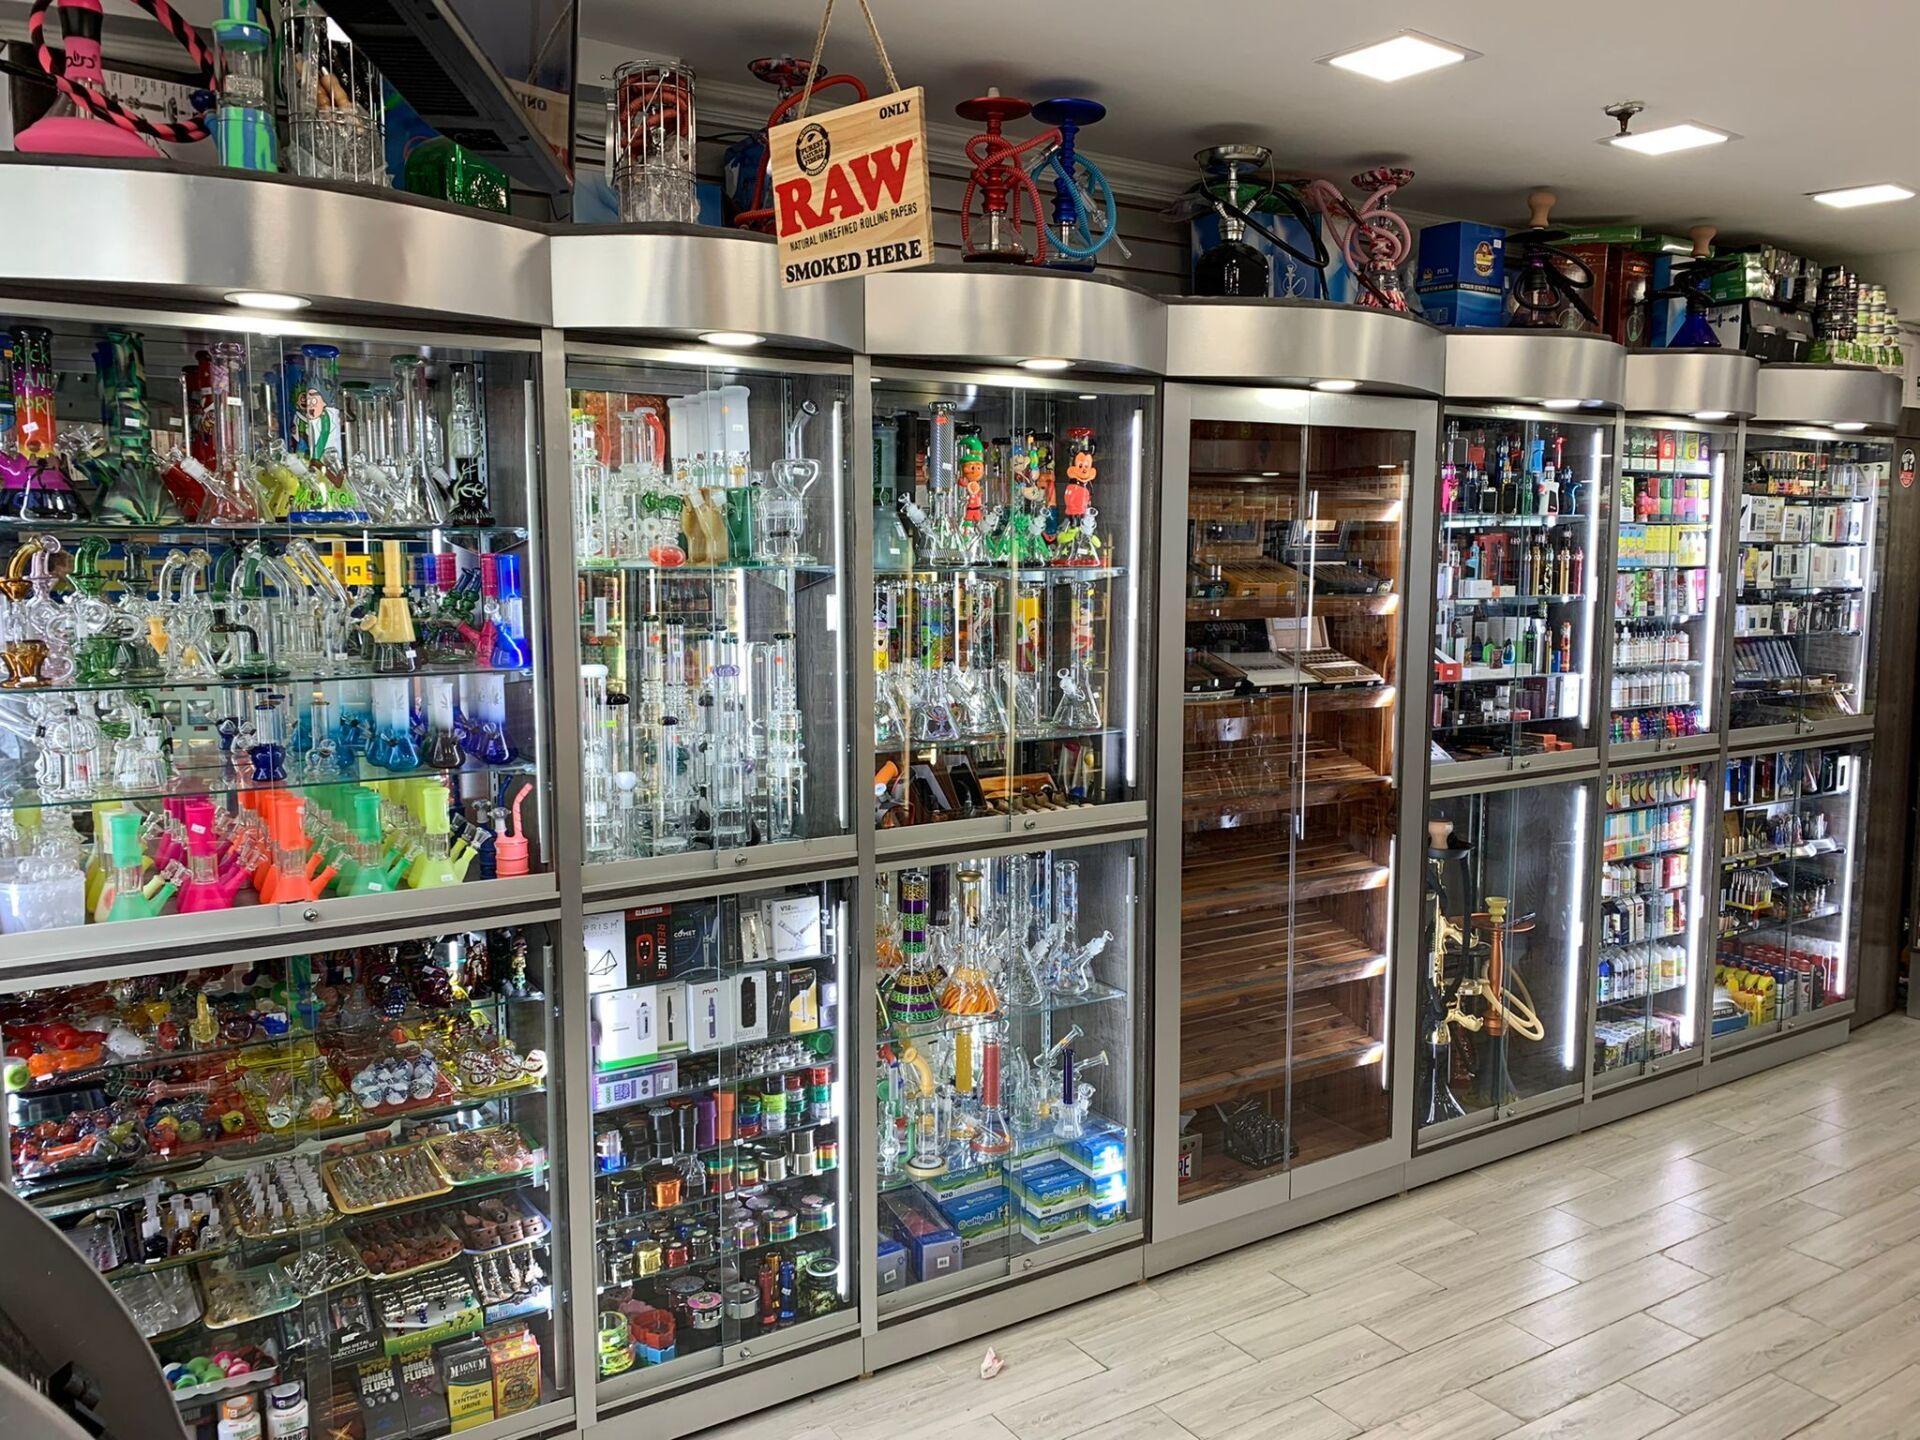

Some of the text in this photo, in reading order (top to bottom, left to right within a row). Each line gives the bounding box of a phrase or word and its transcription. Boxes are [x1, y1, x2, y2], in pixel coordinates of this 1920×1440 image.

[879, 100, 911, 119] ONLY
[801, 139, 824, 153] PUREST
[802, 148, 824, 160] NATURAL
[775, 138, 914, 238] RAW
[790, 202, 918, 251] NATURAL UNREFINED ROLLING PAPERS
[786, 239, 922, 283] SMOKED HERE
[13, 345, 49, 363] RICK
[583, 922, 617, 931] PRISM
[674, 928, 696, 938] COMET
[402, 1358, 433, 1374] DOUBLE
[403, 1366, 435, 1383] FLUSH
[450, 1358, 487, 1378] MAGNUM
[361, 1369, 393, 1386] DOUBLE
[362, 1377, 395, 1395] FLUSH
[454, 1390, 488, 1406] SYNTHETIC
[461, 1401, 480, 1411] URINE
